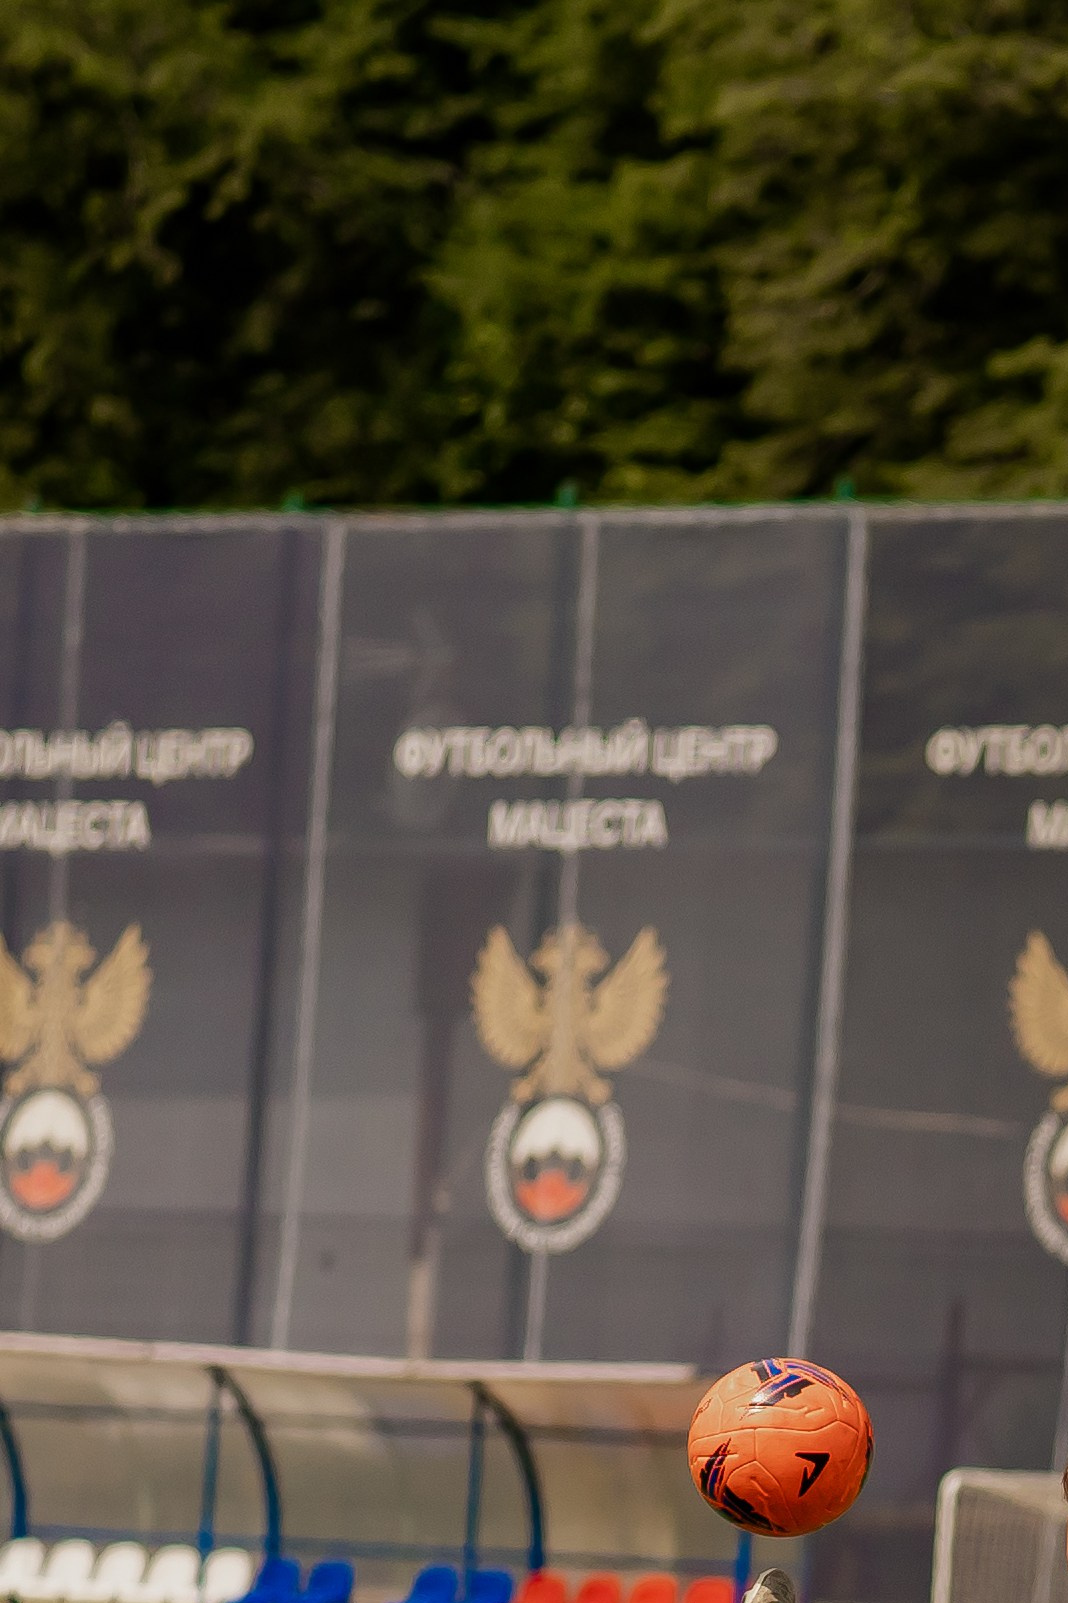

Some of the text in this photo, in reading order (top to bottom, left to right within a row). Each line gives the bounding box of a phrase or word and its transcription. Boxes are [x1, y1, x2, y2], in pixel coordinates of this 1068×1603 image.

[134, 727, 254, 787] ЦЕНТР
[394, 718, 778, 784] ФУТБОЛЬНЫЙ ЦЕНТР
[487, 798, 669, 854] МАЦЕСТА
